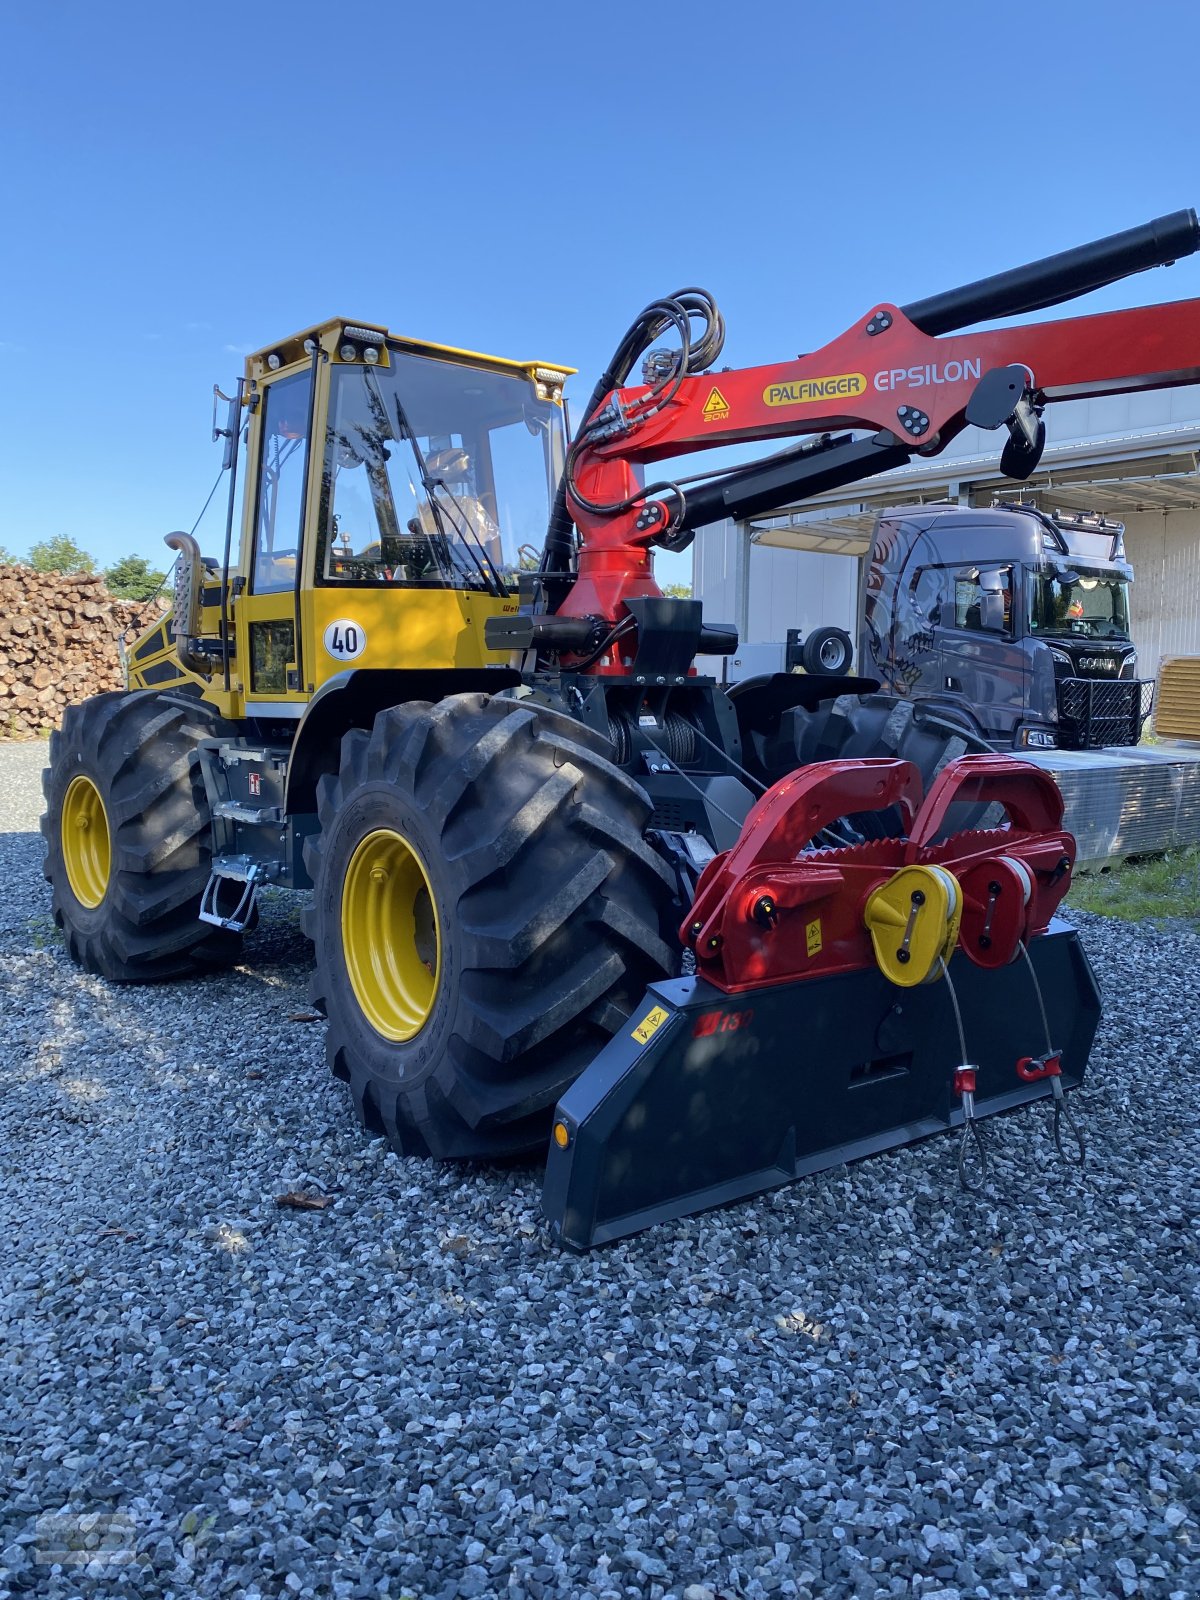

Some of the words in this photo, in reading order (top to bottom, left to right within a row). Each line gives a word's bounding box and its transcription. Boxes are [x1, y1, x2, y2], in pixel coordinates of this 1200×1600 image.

[769, 377, 860, 403] PALFINGER
[873, 358, 981, 391] EPSILON
[704, 411, 729, 422] 20M
[332, 627, 358, 653] 40
[1078, 657, 1117, 671] SCANIA
